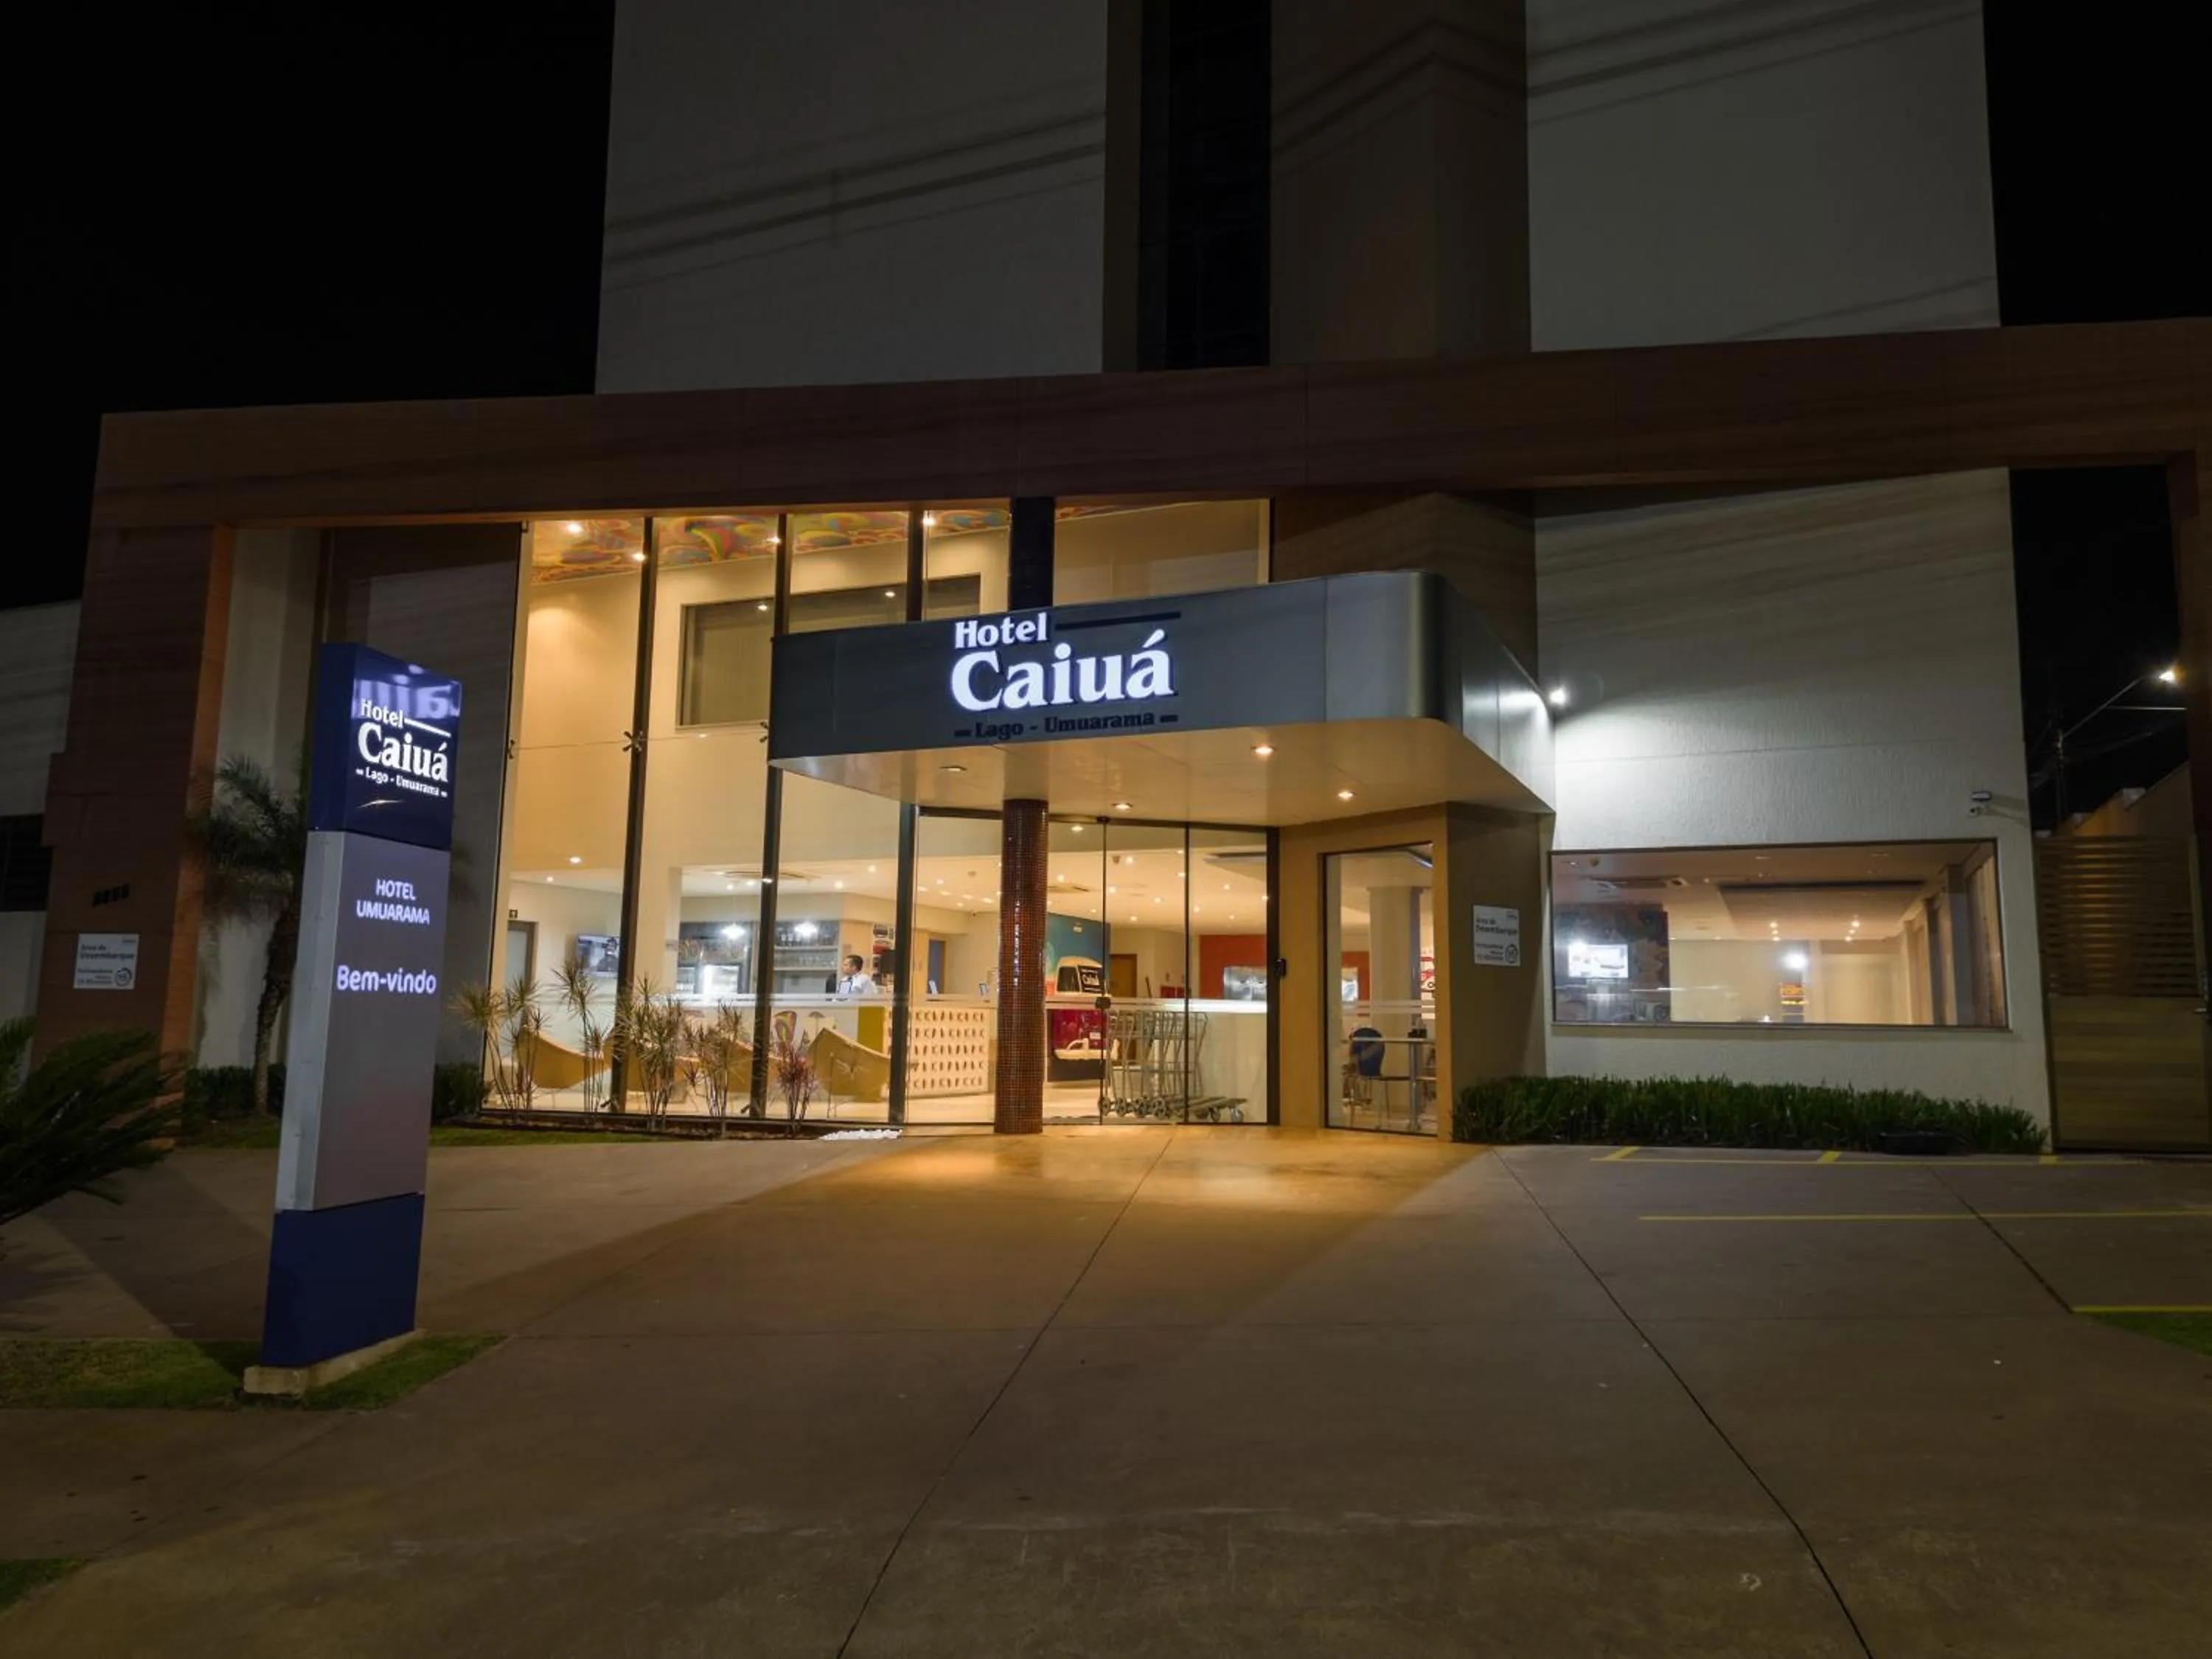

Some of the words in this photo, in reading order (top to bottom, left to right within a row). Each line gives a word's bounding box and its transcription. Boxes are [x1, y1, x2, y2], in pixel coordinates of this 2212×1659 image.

[955, 612, 1048, 649] Hotel
[951, 629, 1177, 712] Caiuá
[361, 698, 403, 728] Hotel
[975, 722, 1023, 740] Lago
[1044, 712, 1155, 733] Umuarama
[358, 722, 449, 782] Caiuá
[365, 766, 388, 784] Lago
[396, 775, 439, 796] Umuarama
[375, 878, 417, 901] HOTEL
[356, 900, 431, 925] UMUARAMA
[336, 964, 437, 994] Bem-vindo
